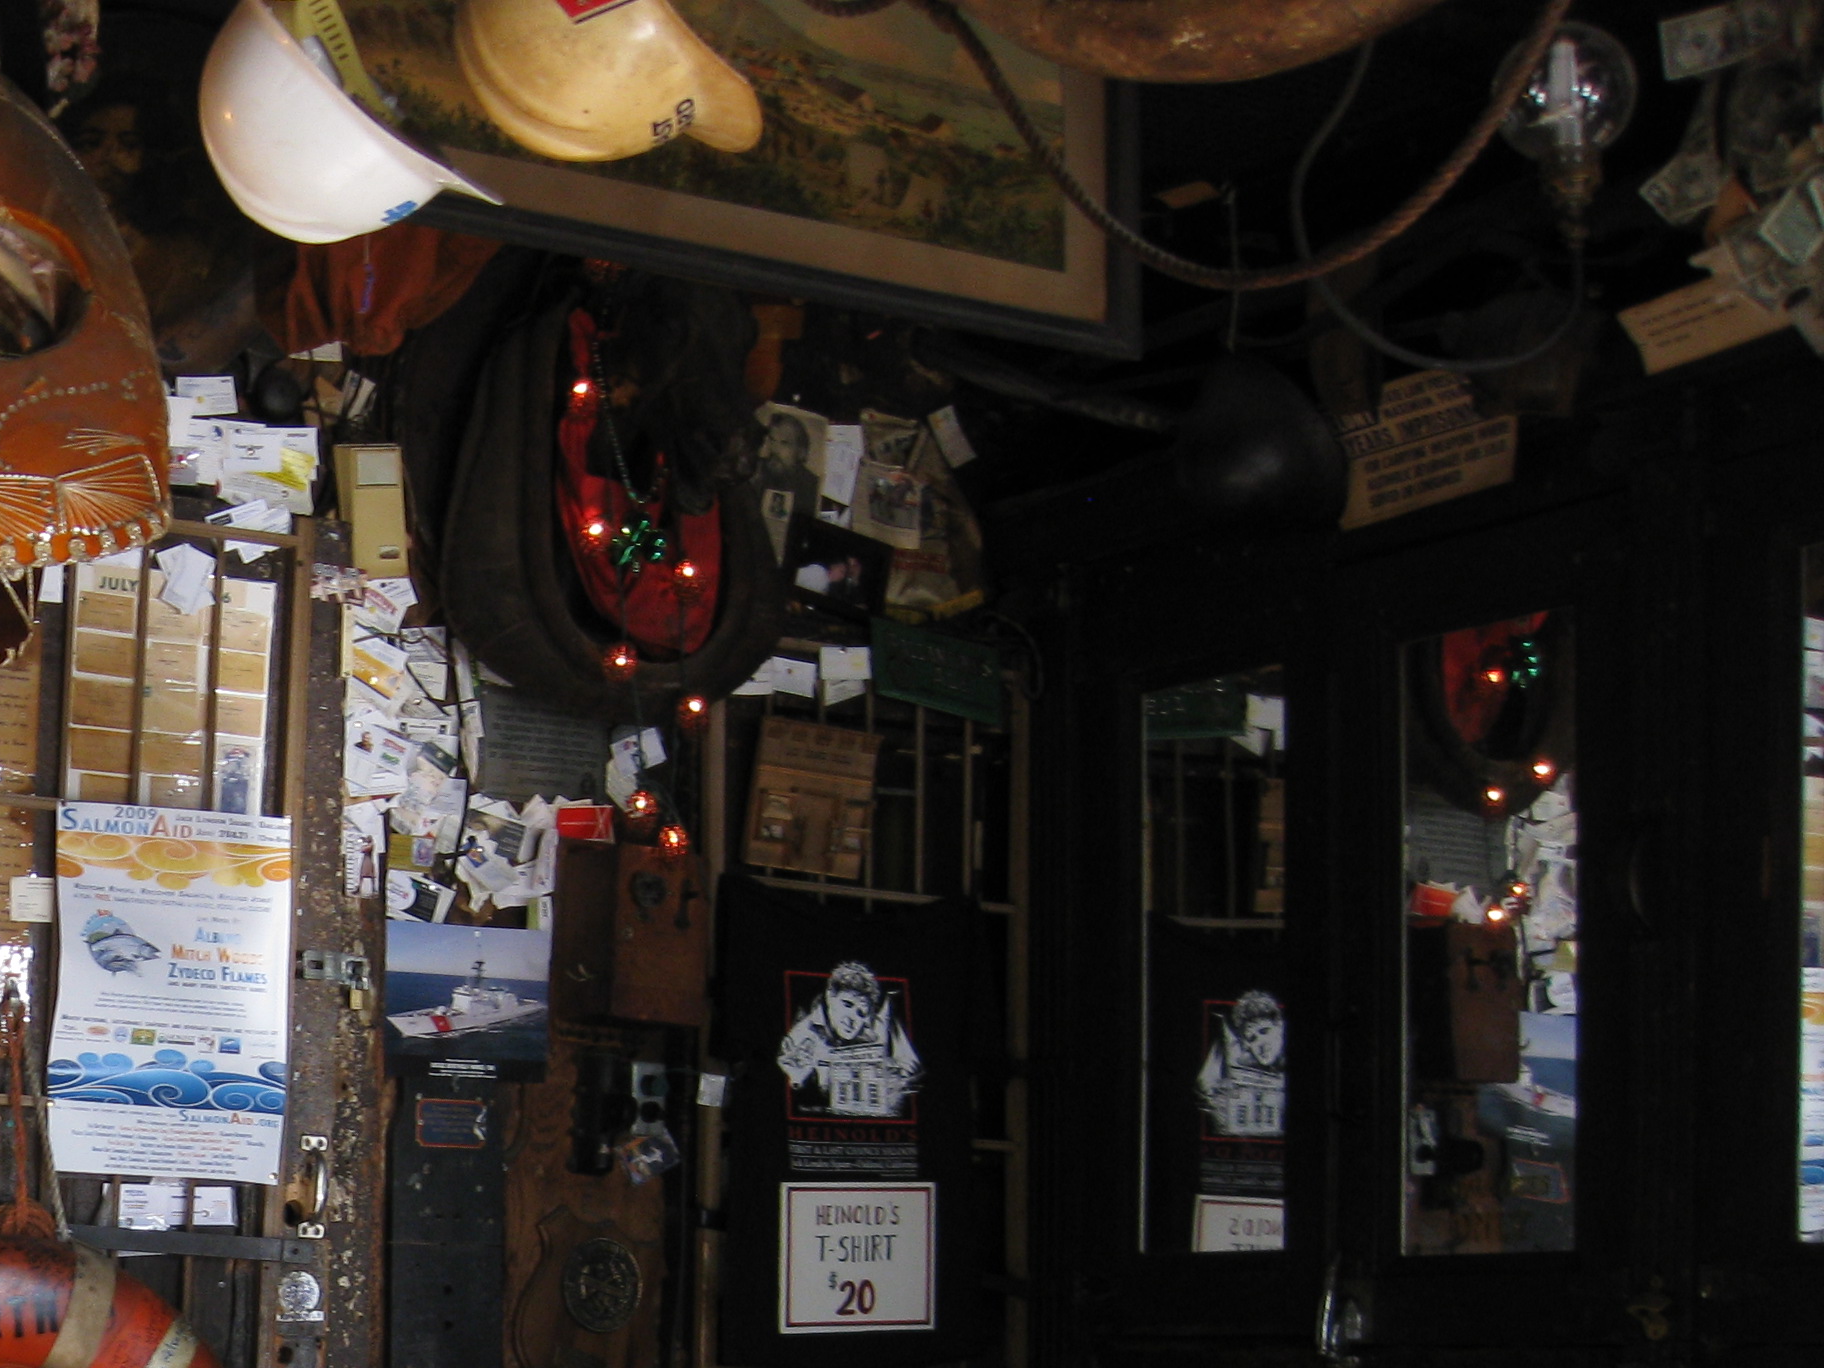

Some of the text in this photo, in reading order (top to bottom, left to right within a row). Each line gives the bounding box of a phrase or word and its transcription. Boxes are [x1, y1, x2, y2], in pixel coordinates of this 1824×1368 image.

[99, 574, 141, 593] JULY
[114, 806, 158, 821] 2009
[787, 1126, 920, 1142] HEINOLD'S
[815, 1203, 901, 1226] HEINOLD'S
[815, 1234, 897, 1263] T-SHIRT
